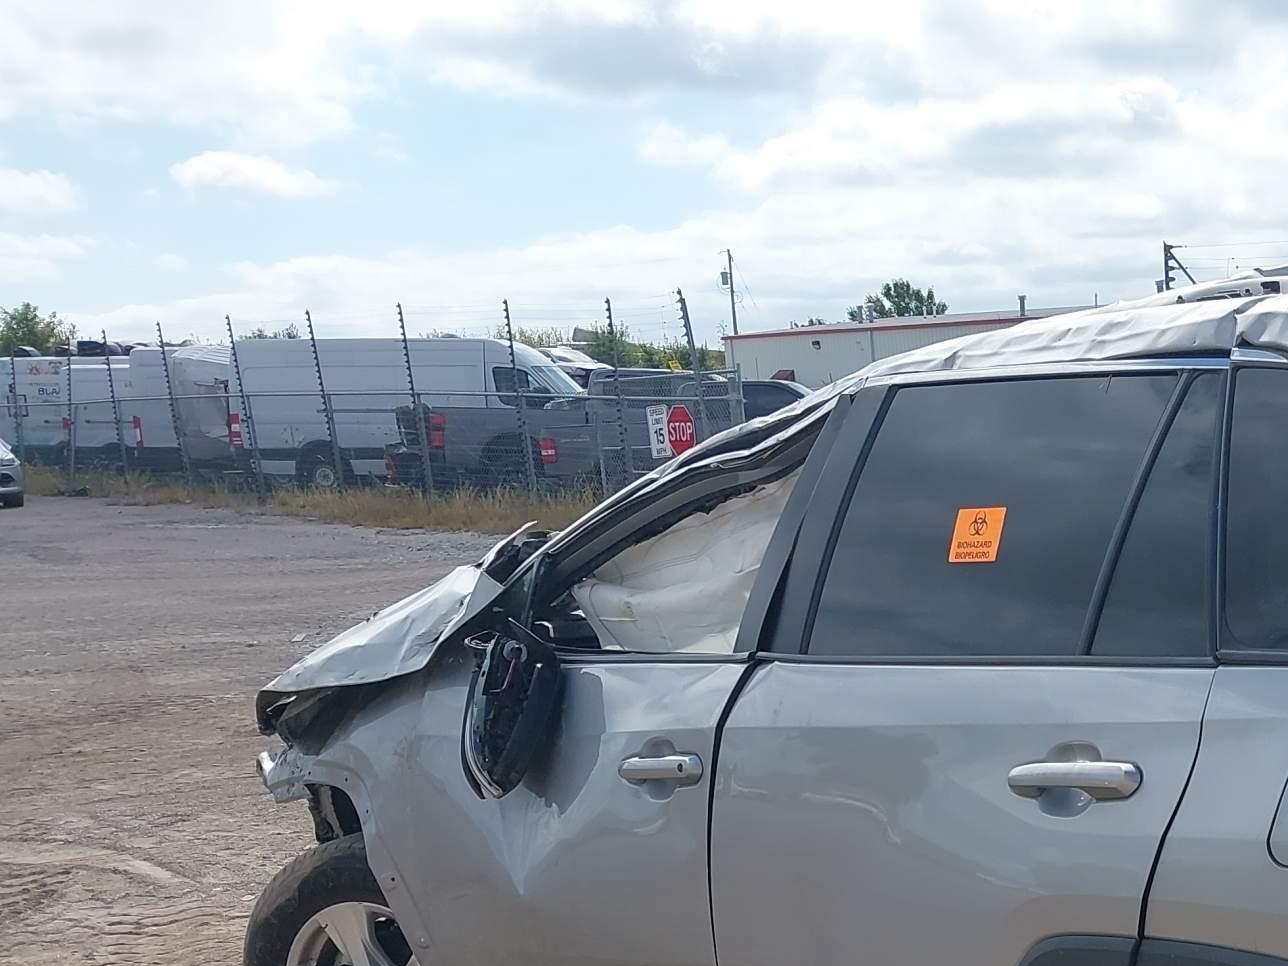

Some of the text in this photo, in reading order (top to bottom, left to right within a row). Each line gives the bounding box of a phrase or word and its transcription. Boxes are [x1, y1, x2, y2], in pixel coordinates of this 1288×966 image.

[654, 428, 666, 445] 15
[669, 422, 693, 441] STOP
[957, 541, 992, 549] BIOHAZARD
[955, 551, 990, 559] BIOPELIGRO
